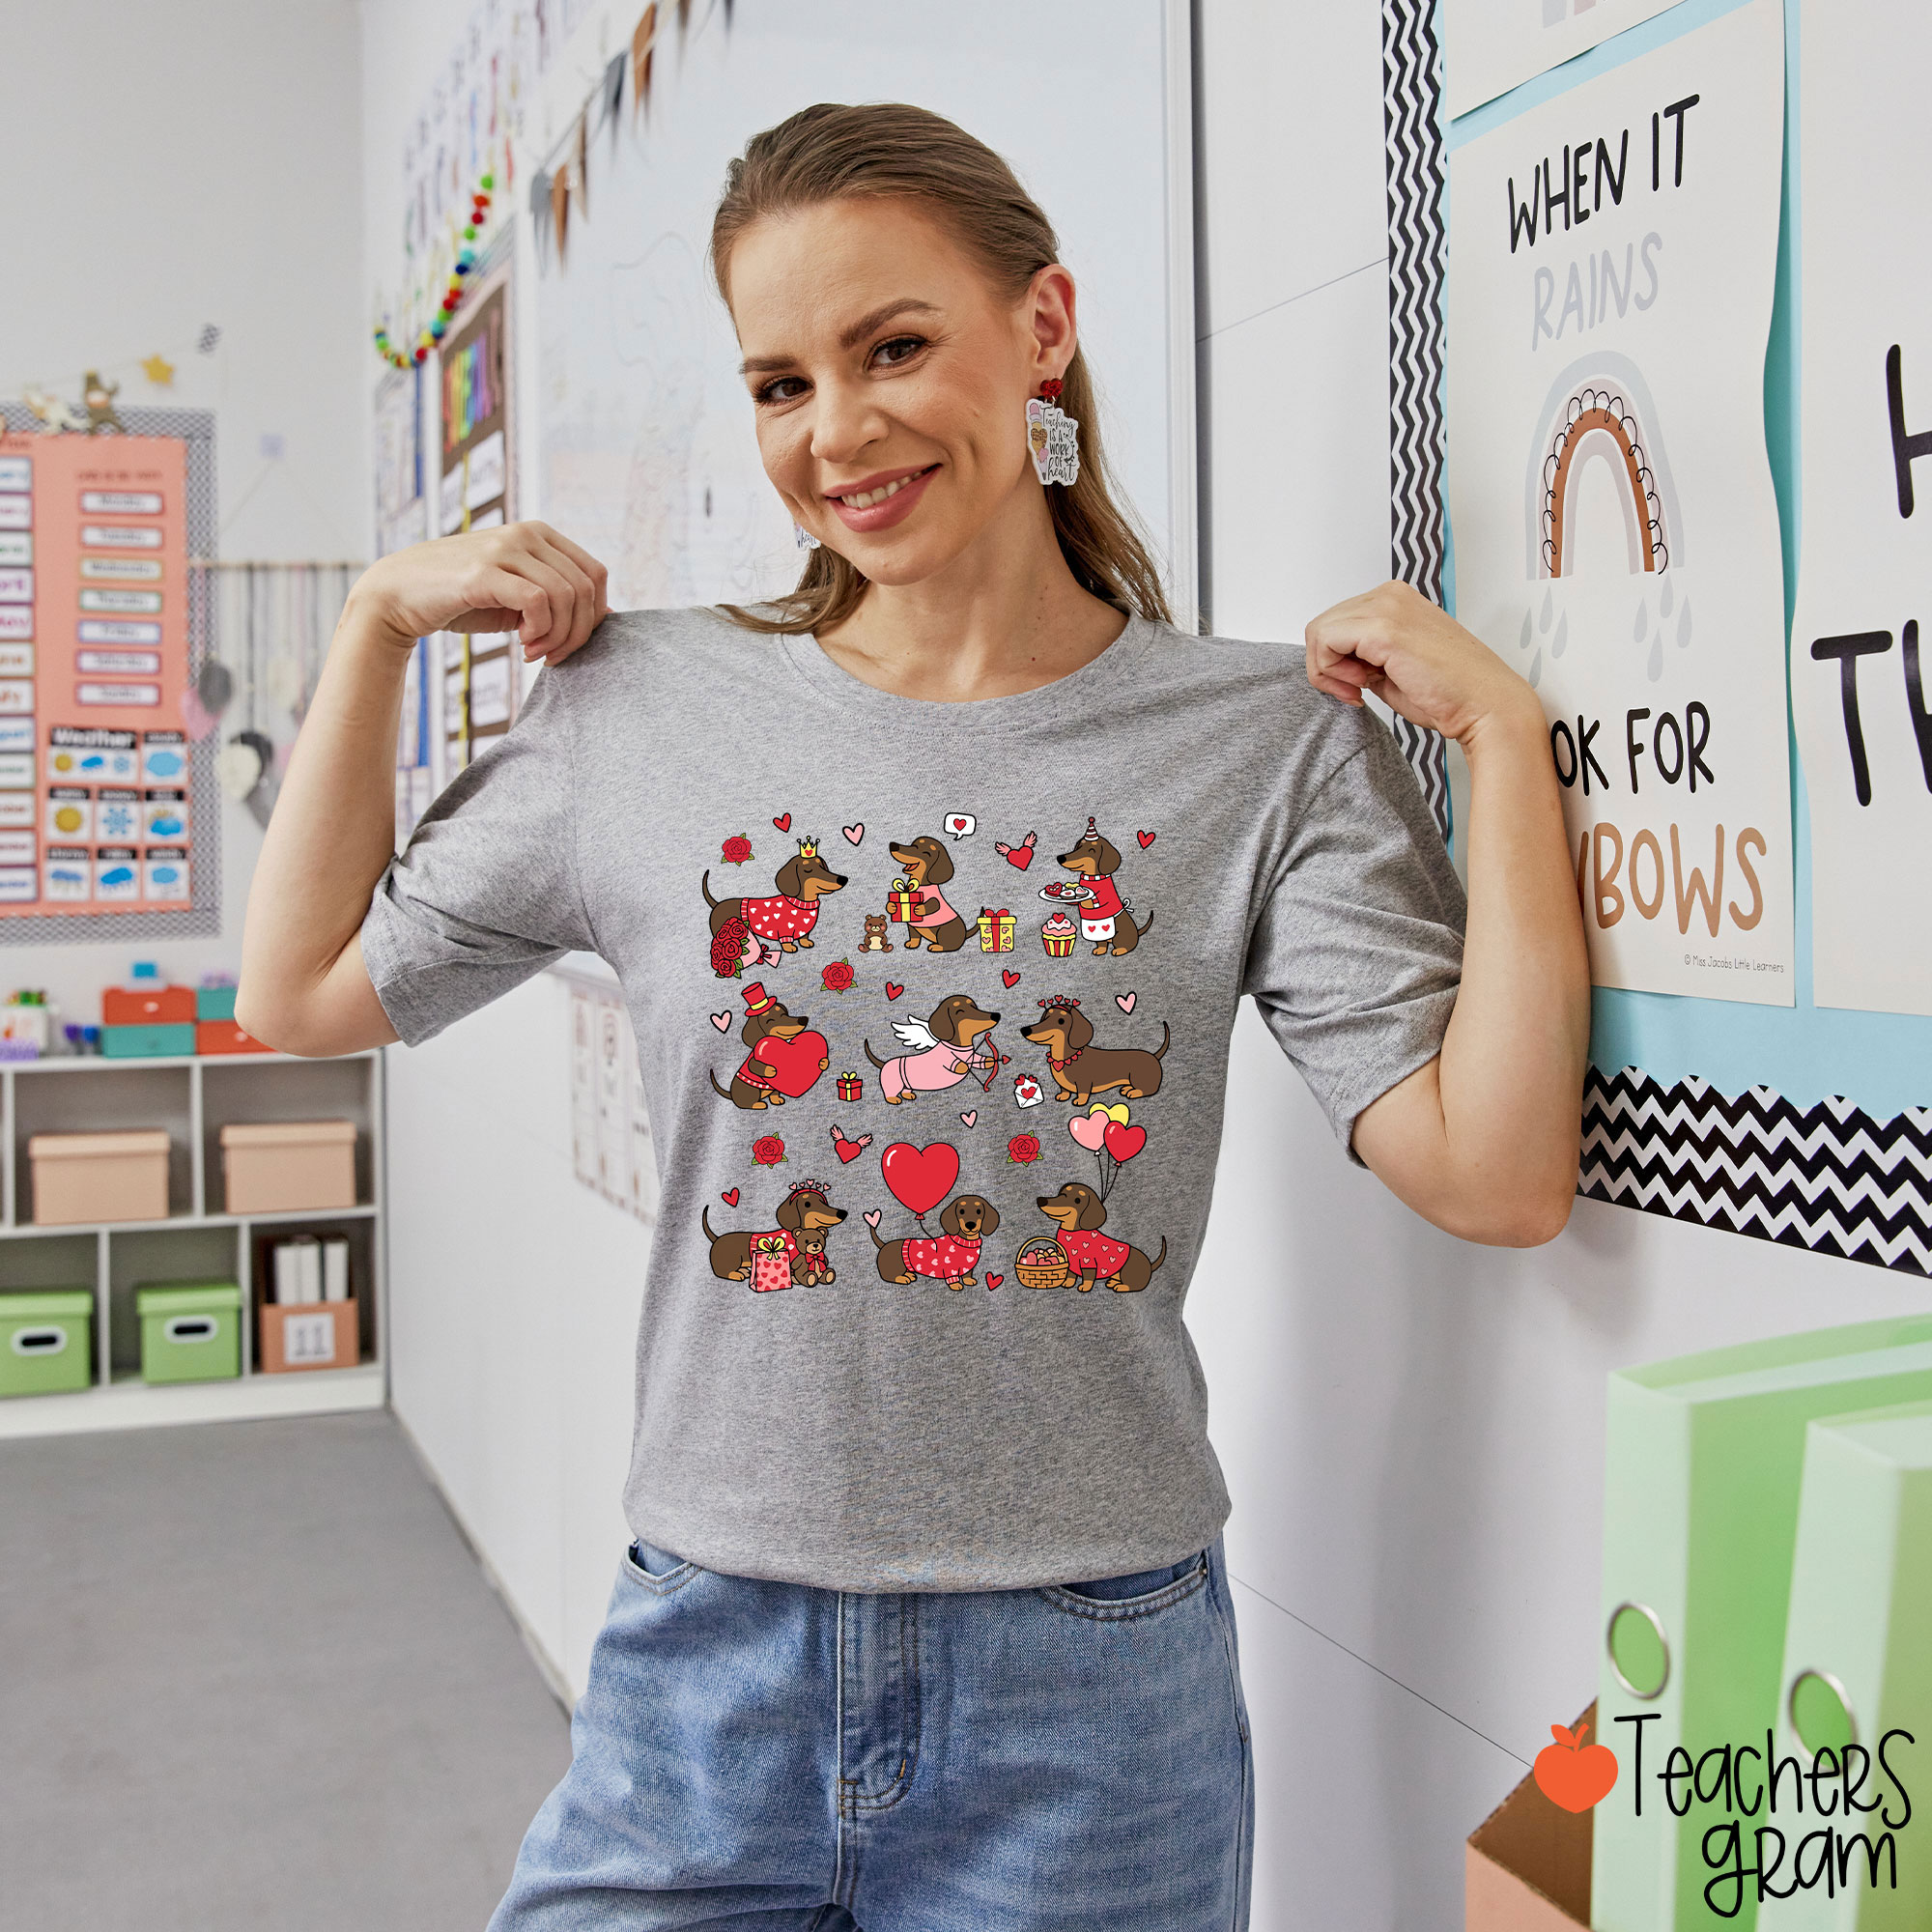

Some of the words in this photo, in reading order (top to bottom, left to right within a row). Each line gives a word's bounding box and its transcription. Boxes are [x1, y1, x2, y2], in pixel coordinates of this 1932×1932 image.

[1508, 128, 1629, 253] WHEN
[1652, 94, 1700, 191] IT
[1532, 232, 1662, 352] RAINS
[1048, 456, 1076, 482] heart
[1550, 715, 1609, 796] OK
[1627, 701, 1715, 794] FOR
[1577, 822, 1767, 937] BOWS
[1692, 954, 1706, 967] Miss
[1708, 955, 1732, 970] Jacobs
[1734, 957, 1750, 970] Little
[1752, 959, 1784, 973] Learners
